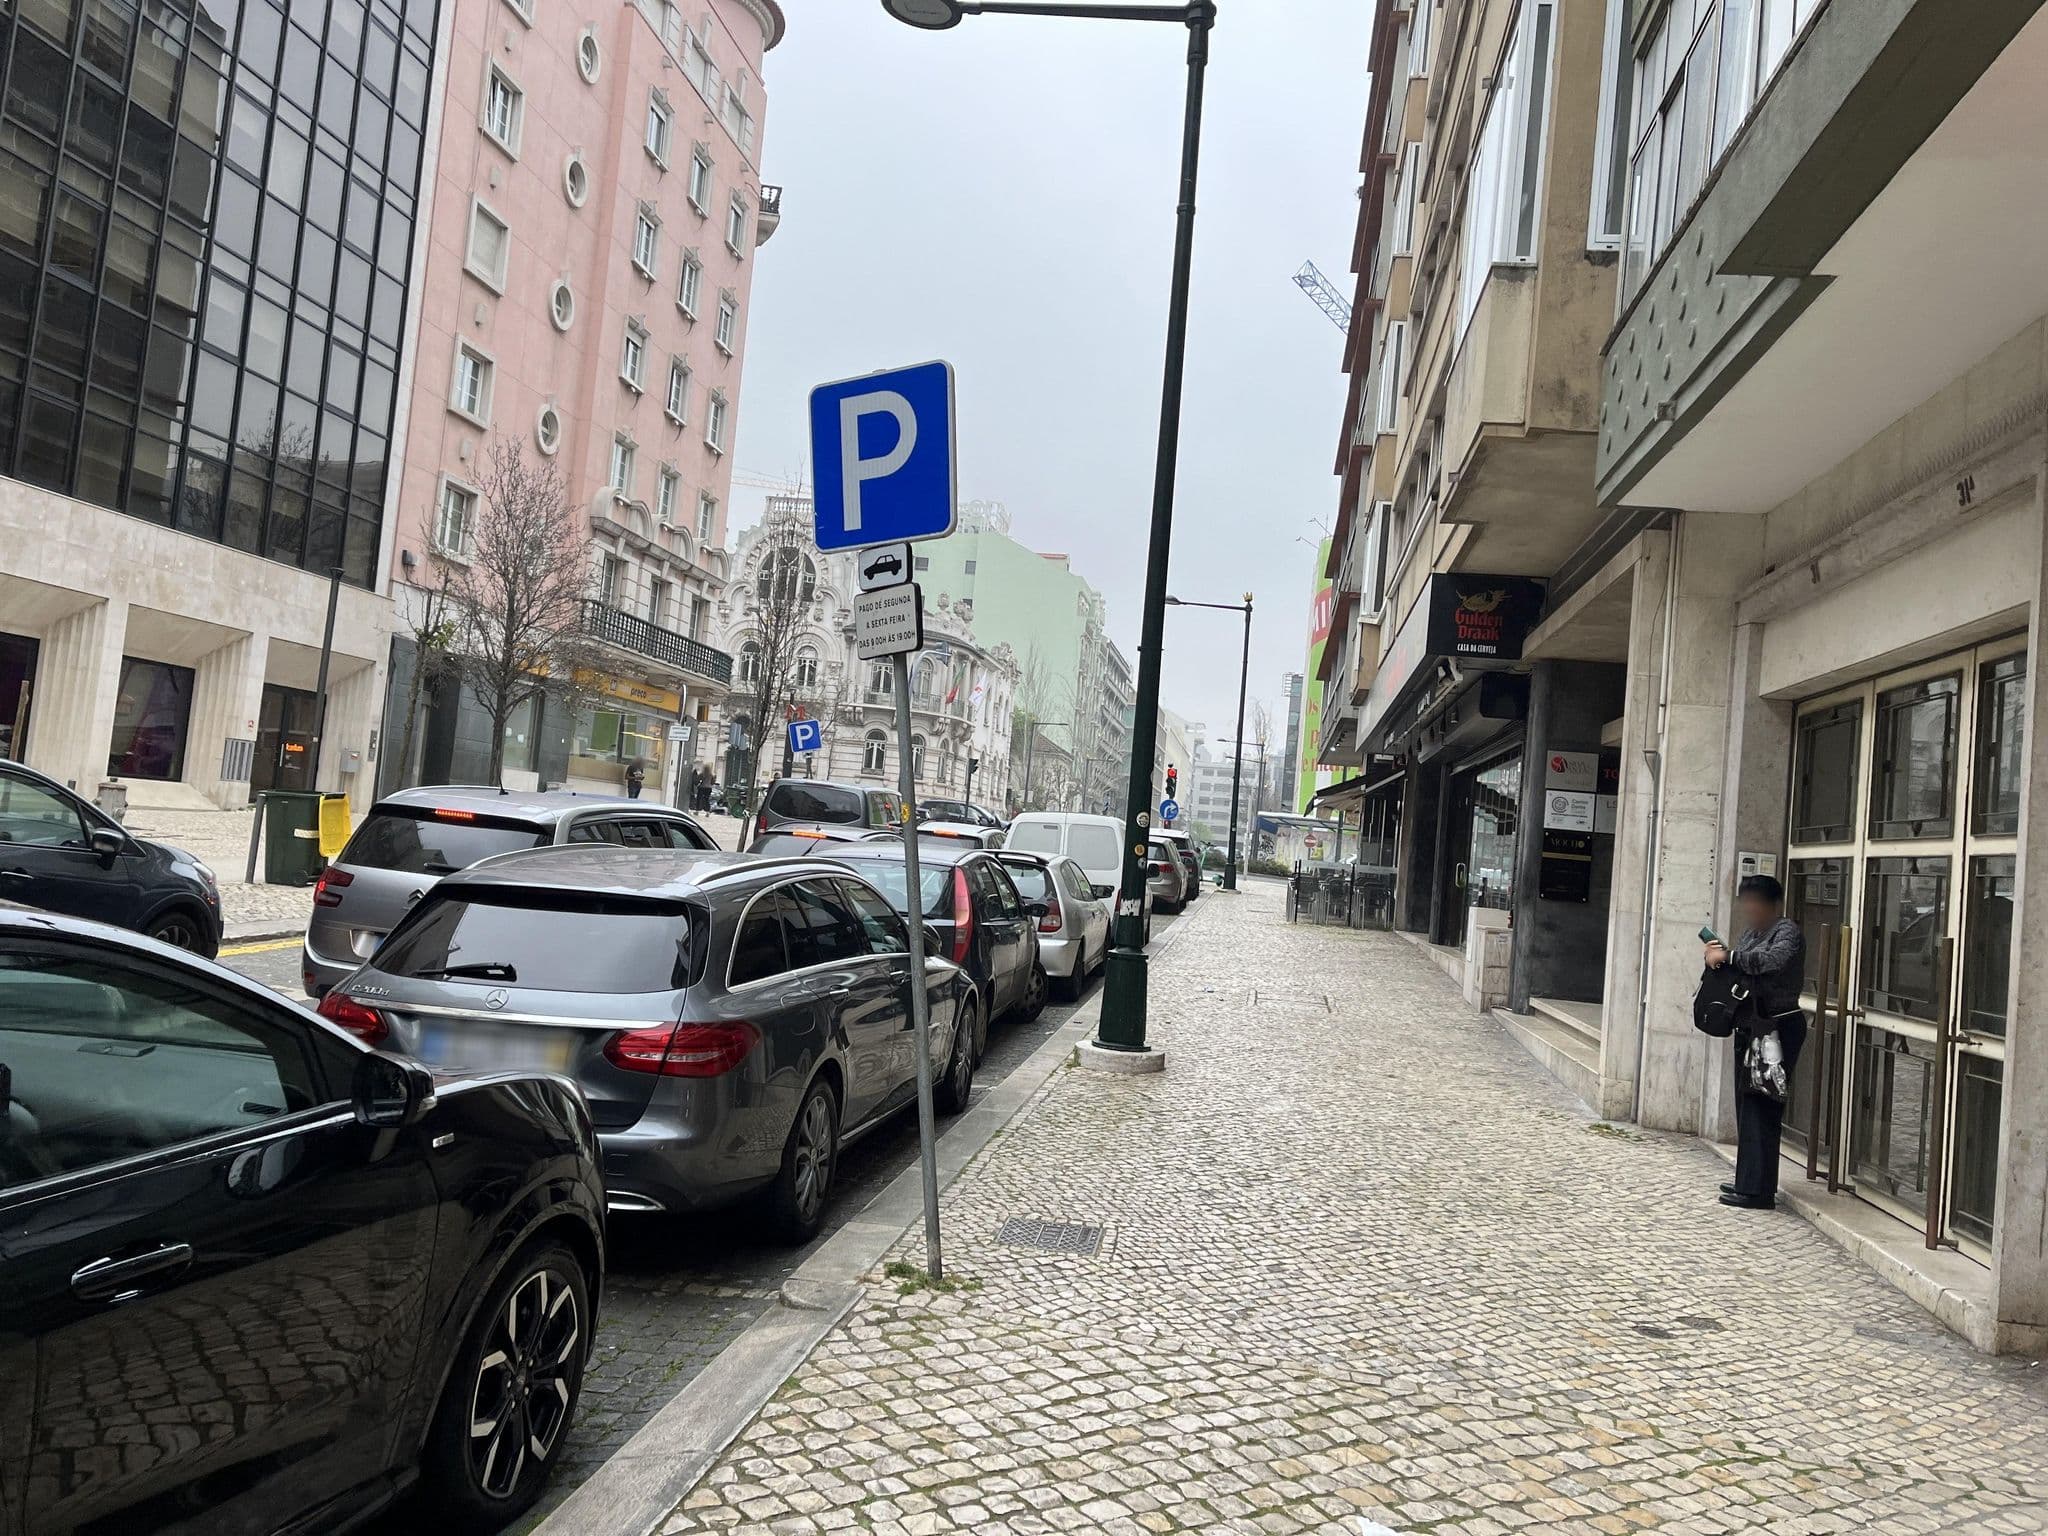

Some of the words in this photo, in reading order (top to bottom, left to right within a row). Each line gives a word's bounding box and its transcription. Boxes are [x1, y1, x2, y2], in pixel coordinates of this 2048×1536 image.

[840, 390, 918, 532] P
[858, 602, 874, 613] PAGO
[875, 601, 883, 610] DE
[883, 594, 912, 608] SEGUNDA
[871, 618, 888, 629] SEXTA
[889, 614, 906, 625] FEIRA
[858, 639, 870, 649] DAS
[1457, 643, 1469, 652] CASA
[1470, 644, 1477, 653] DA
[1477, 644, 1497, 654] CERVEJA
[795, 724, 814, 749] P
